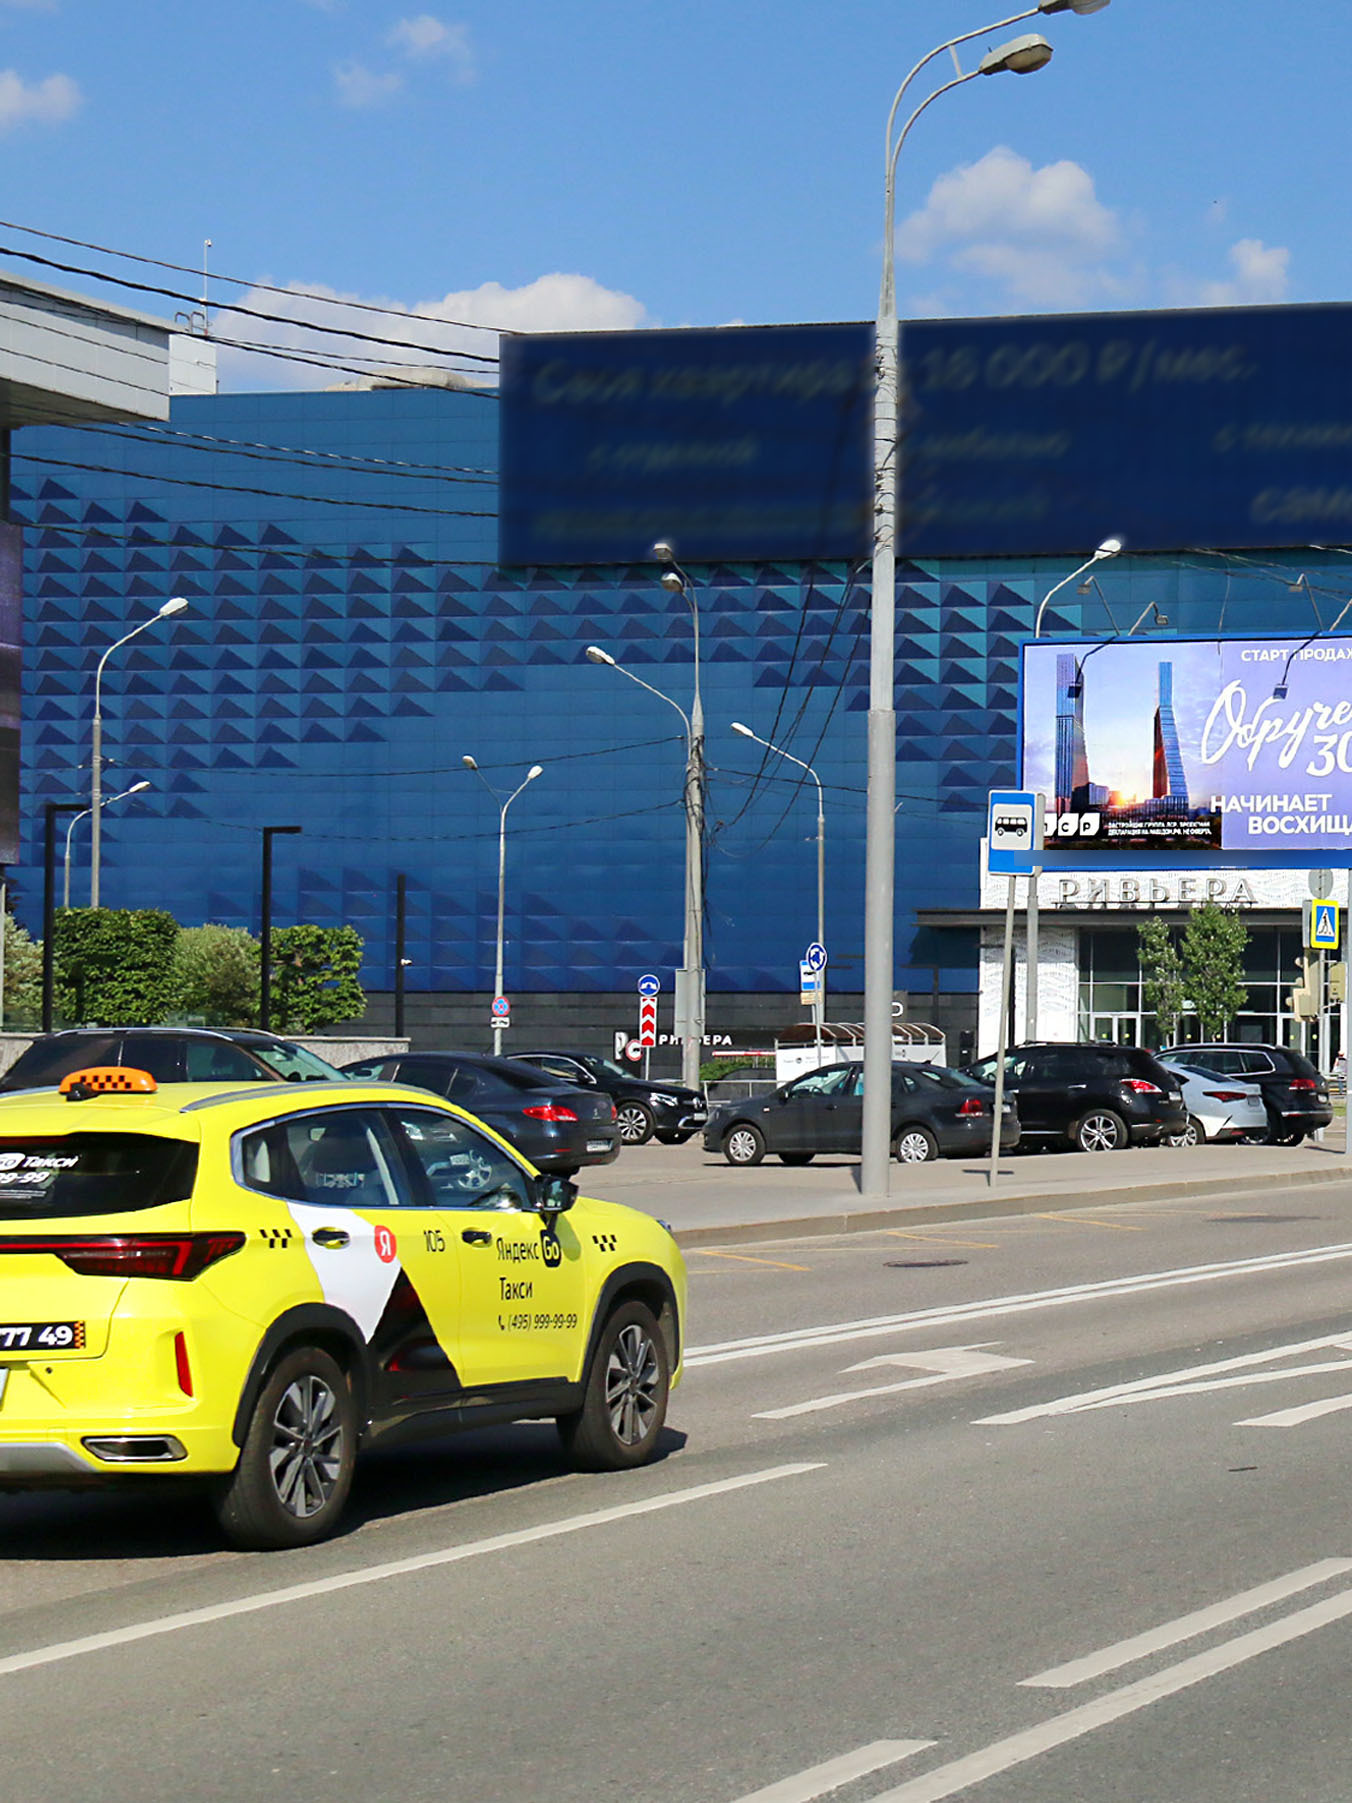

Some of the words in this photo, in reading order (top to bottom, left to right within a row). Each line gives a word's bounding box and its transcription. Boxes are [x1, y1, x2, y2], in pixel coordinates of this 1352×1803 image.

[1241, 649, 1289, 661] СТАРТ
[1210, 794, 1332, 813] НАЧИНАЕТ
[1059, 878, 1256, 903] РИВЬЕРА
[659, 1034, 732, 1045] РИЕРА
[23, 1155, 79, 1168] Такси
[379, 1230, 392, 1257] Я
[424, 1230, 446, 1252] 105
[496, 1237, 539, 1263] Яндекс
[542, 1235, 560, 1261] Go
[500, 1277, 533, 1300] Такси
[508, 1314, 532, 1331] (495)
[534, 1313, 578, 1330] 999-99-99
[38, 1325, 73, 1346] 49
